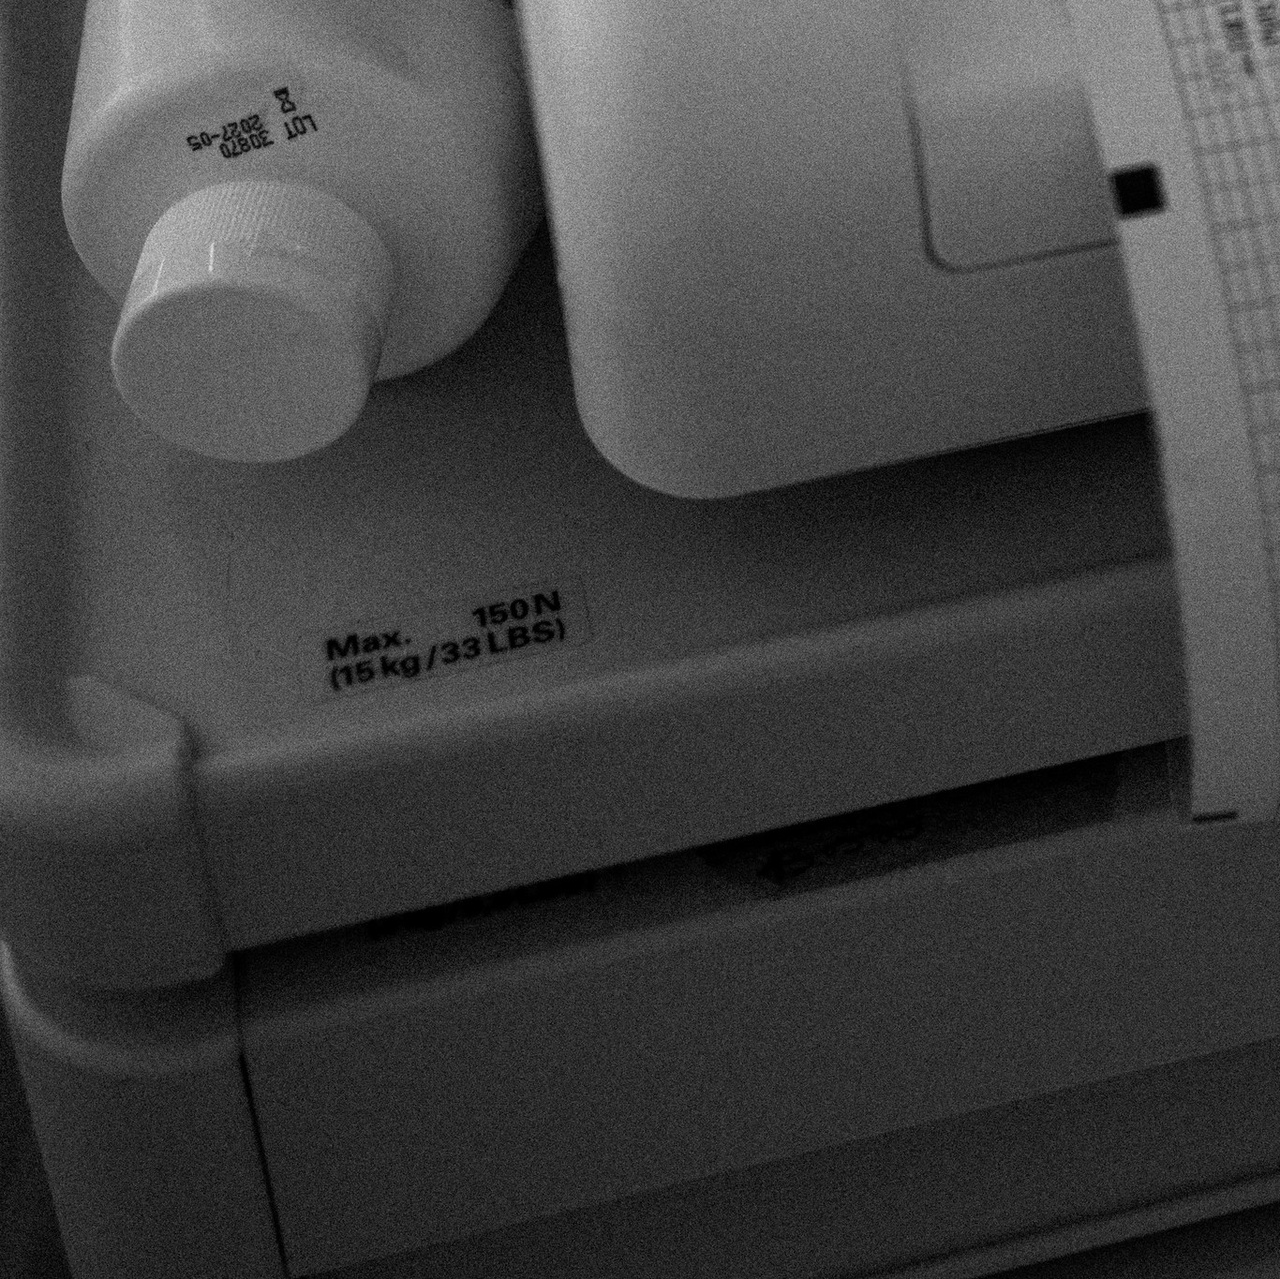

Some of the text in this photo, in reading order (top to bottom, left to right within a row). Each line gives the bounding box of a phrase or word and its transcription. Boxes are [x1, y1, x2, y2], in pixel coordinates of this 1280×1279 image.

[187, 114, 263, 151] 2027-05
[219, 114, 318, 159] LOT 30870
[326, 630, 411, 661] Max.
